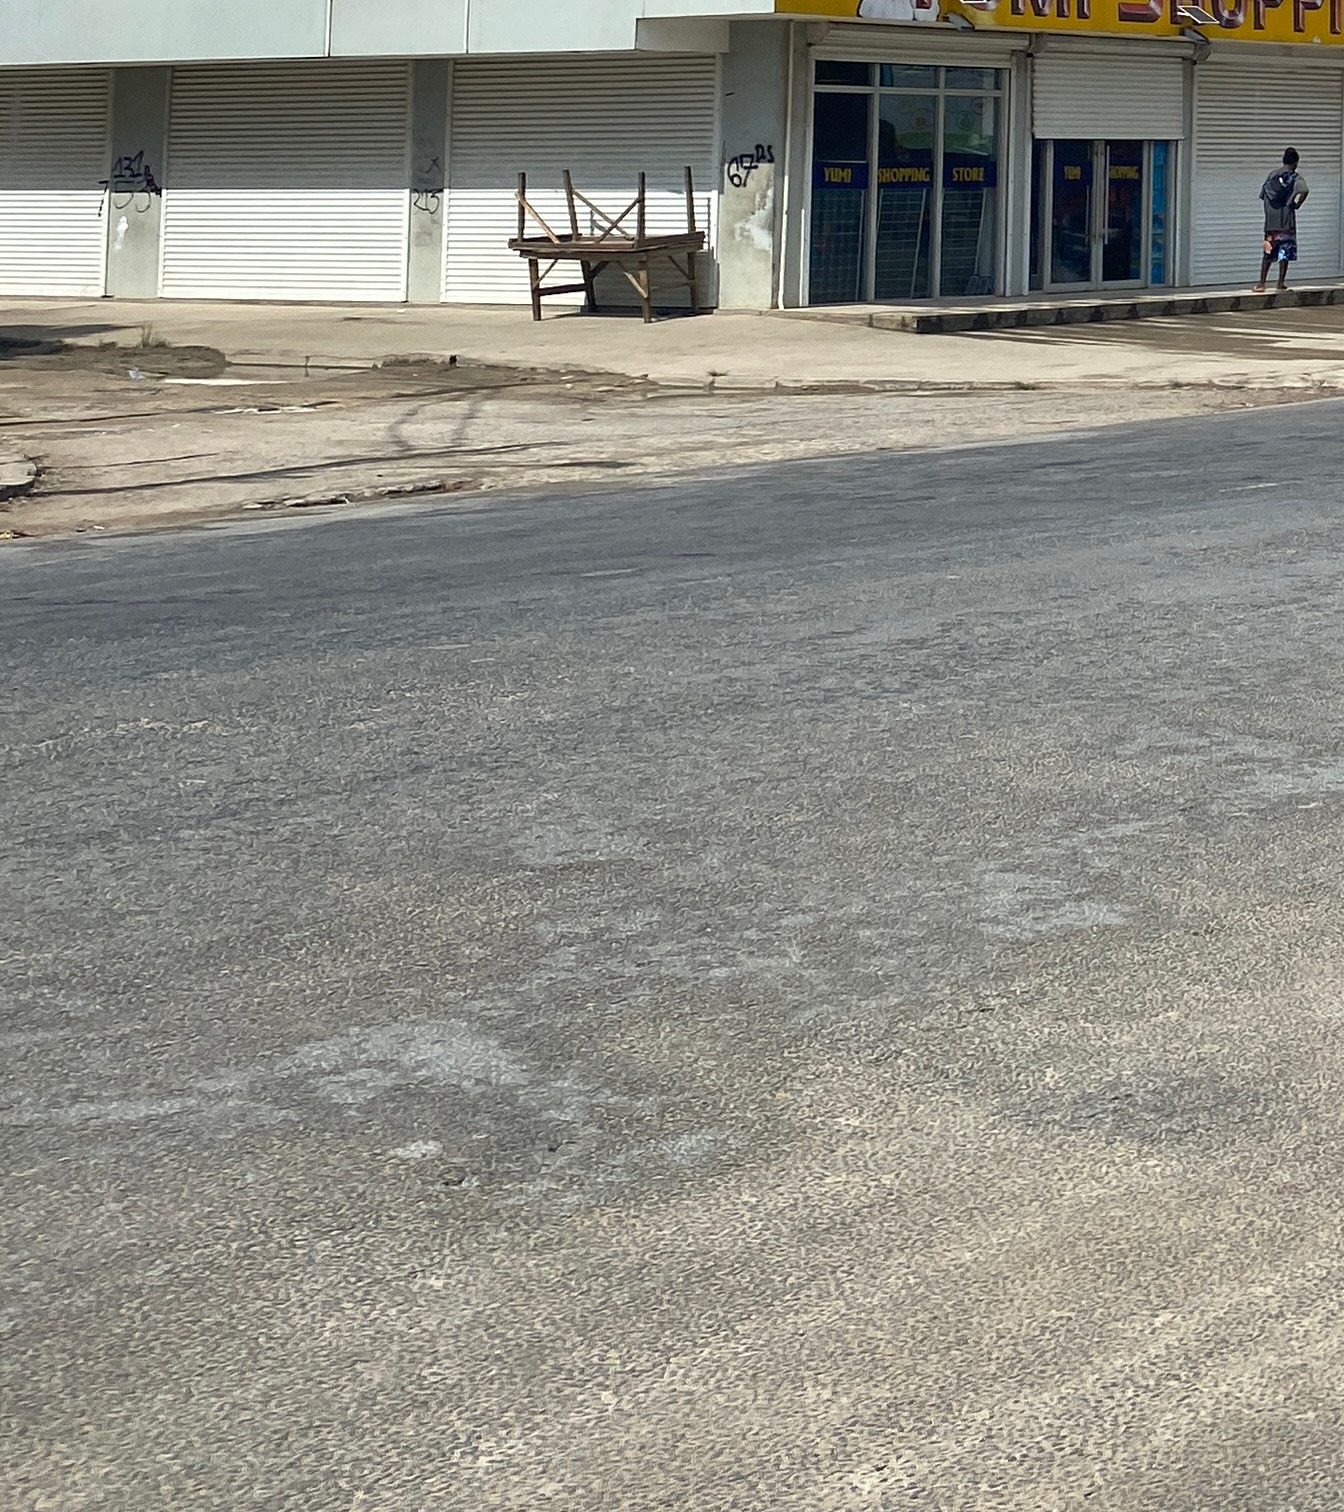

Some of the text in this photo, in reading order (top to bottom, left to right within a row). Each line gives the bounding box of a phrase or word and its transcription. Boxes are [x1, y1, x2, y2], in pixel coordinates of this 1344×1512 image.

[824, 167, 984, 184] YUMI SHOPPING STORE
